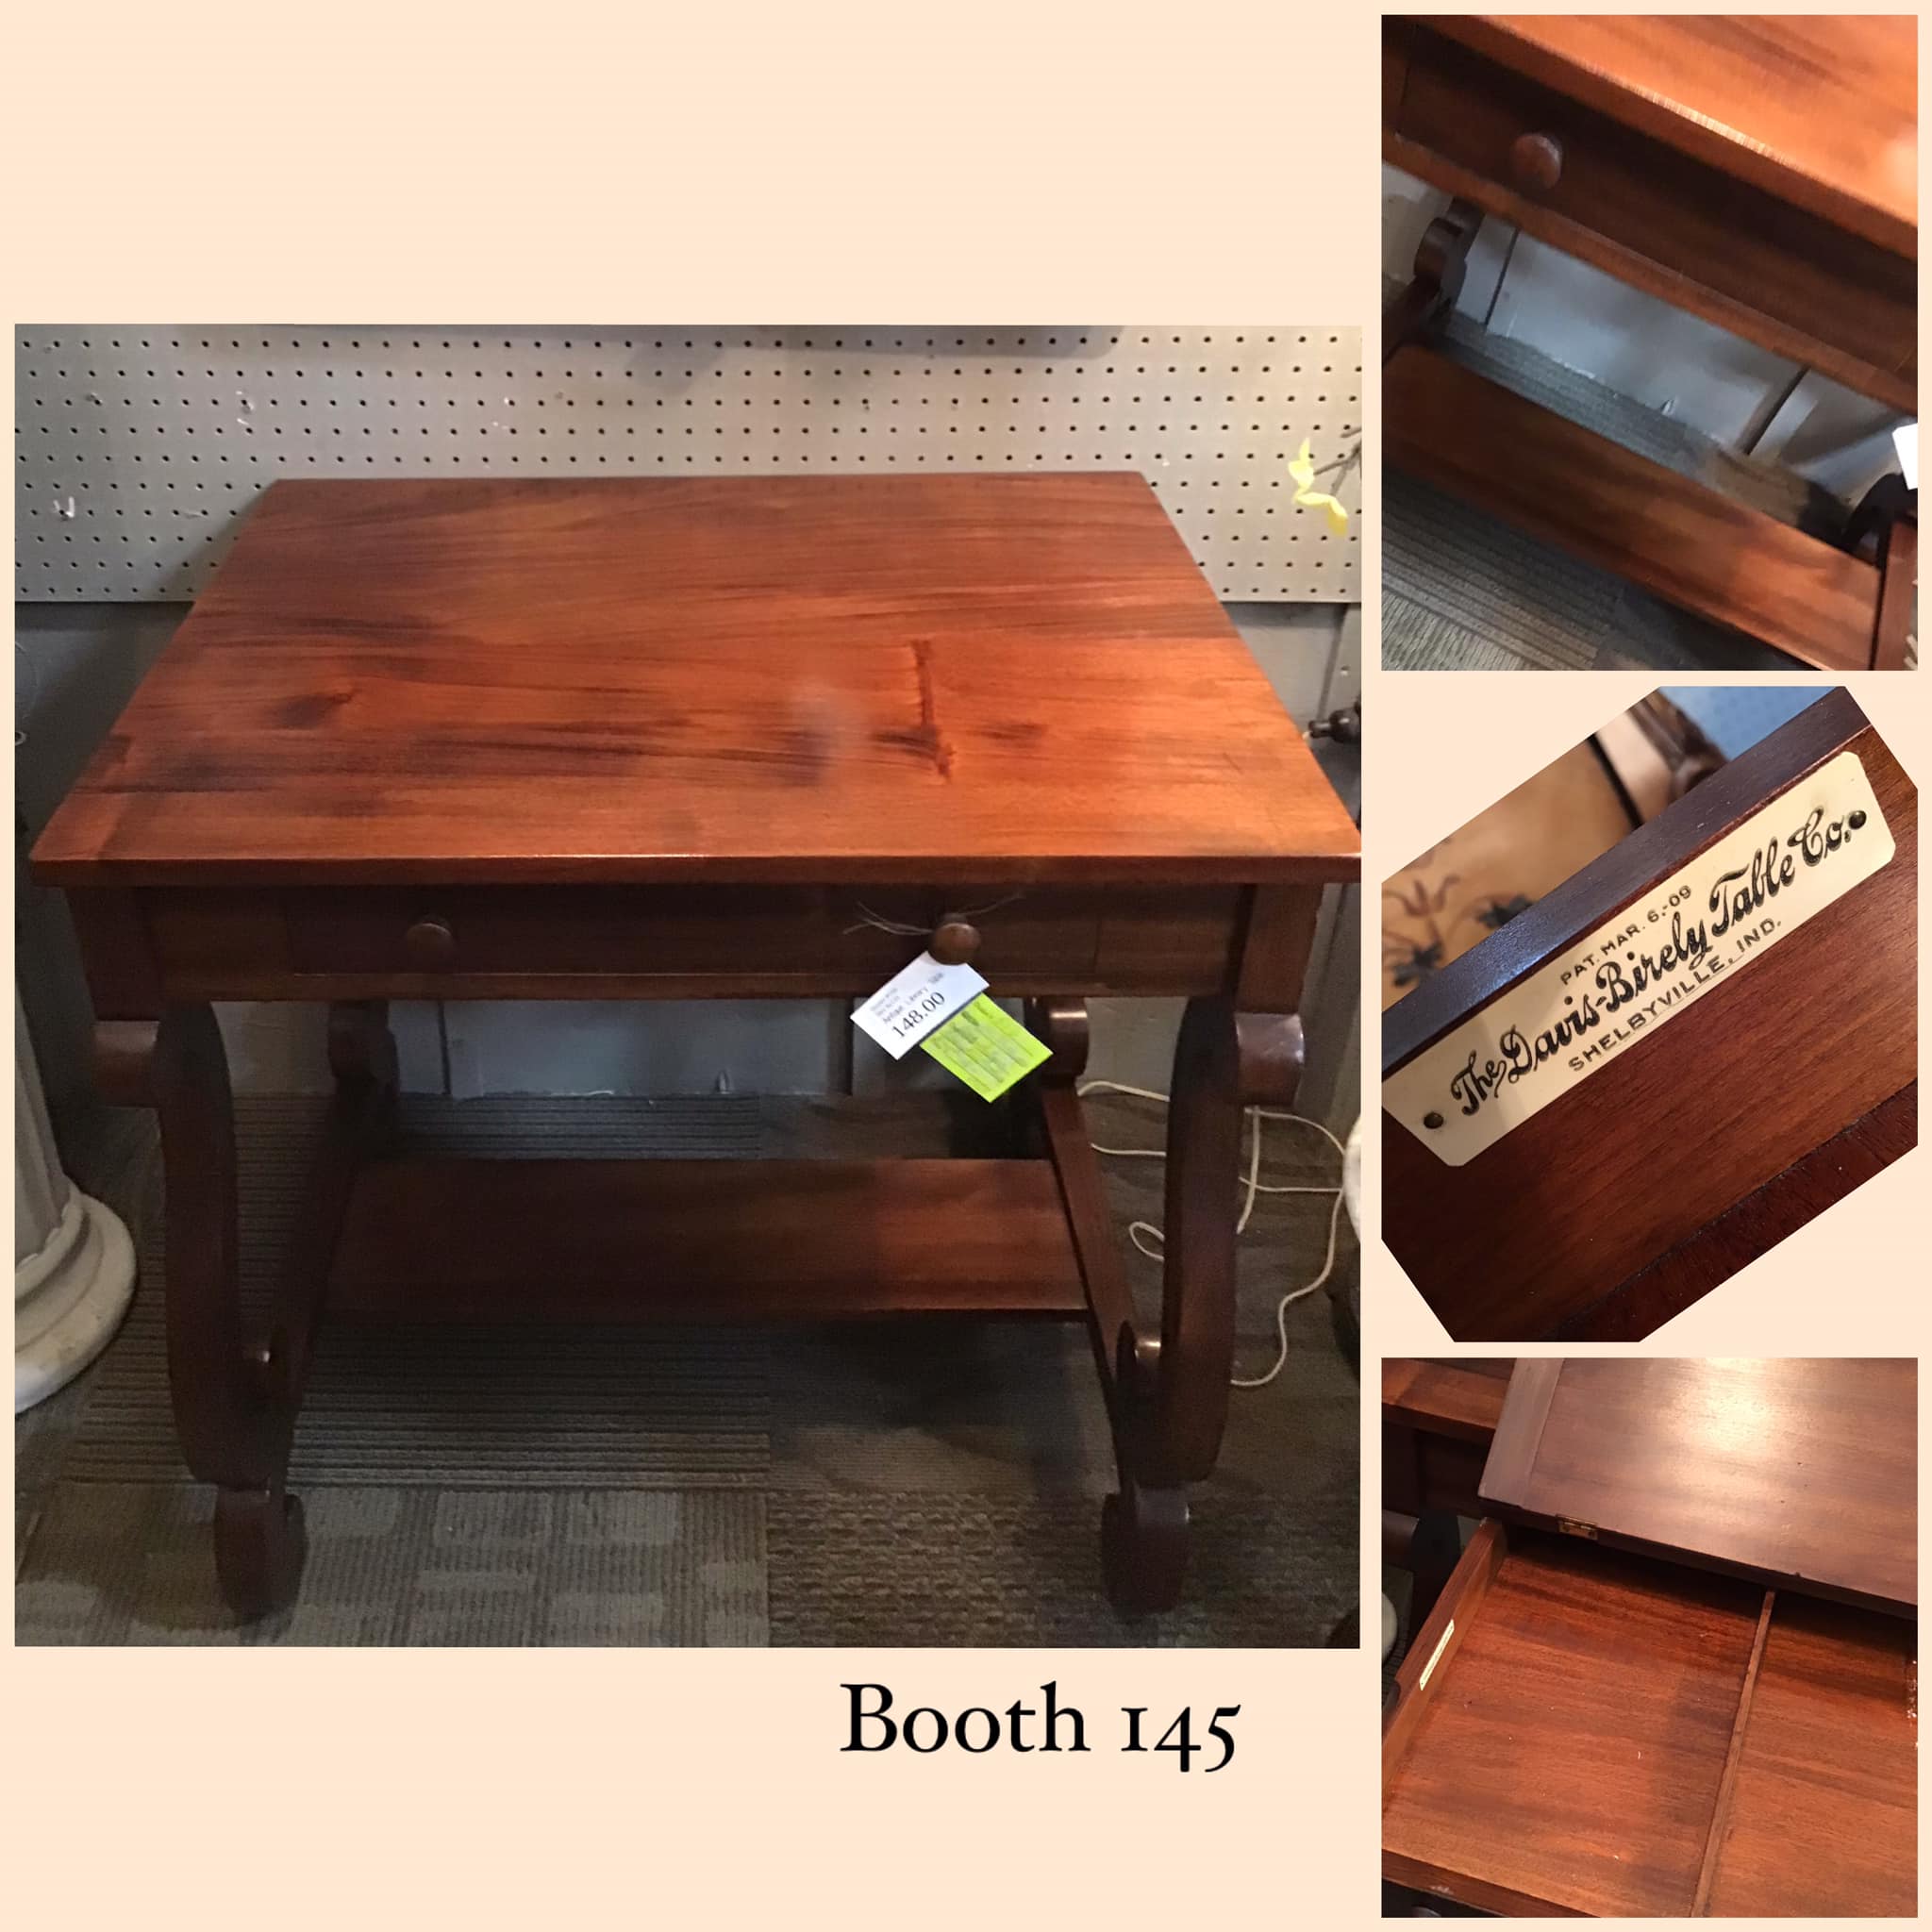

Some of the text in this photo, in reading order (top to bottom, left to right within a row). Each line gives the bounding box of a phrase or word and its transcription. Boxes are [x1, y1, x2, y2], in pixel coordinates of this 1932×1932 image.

[1559, 955, 1602, 987] PAT.
[1602, 924, 1647, 956] MAR.
[1737, 918, 1782, 955] IND.
[1450, 1050, 1507, 1116] The
[1496, 912, 1710, 1083] Davis-Birely
[1708, 836, 1796, 937] Table
[892, 991, 946, 1038] 148.00
